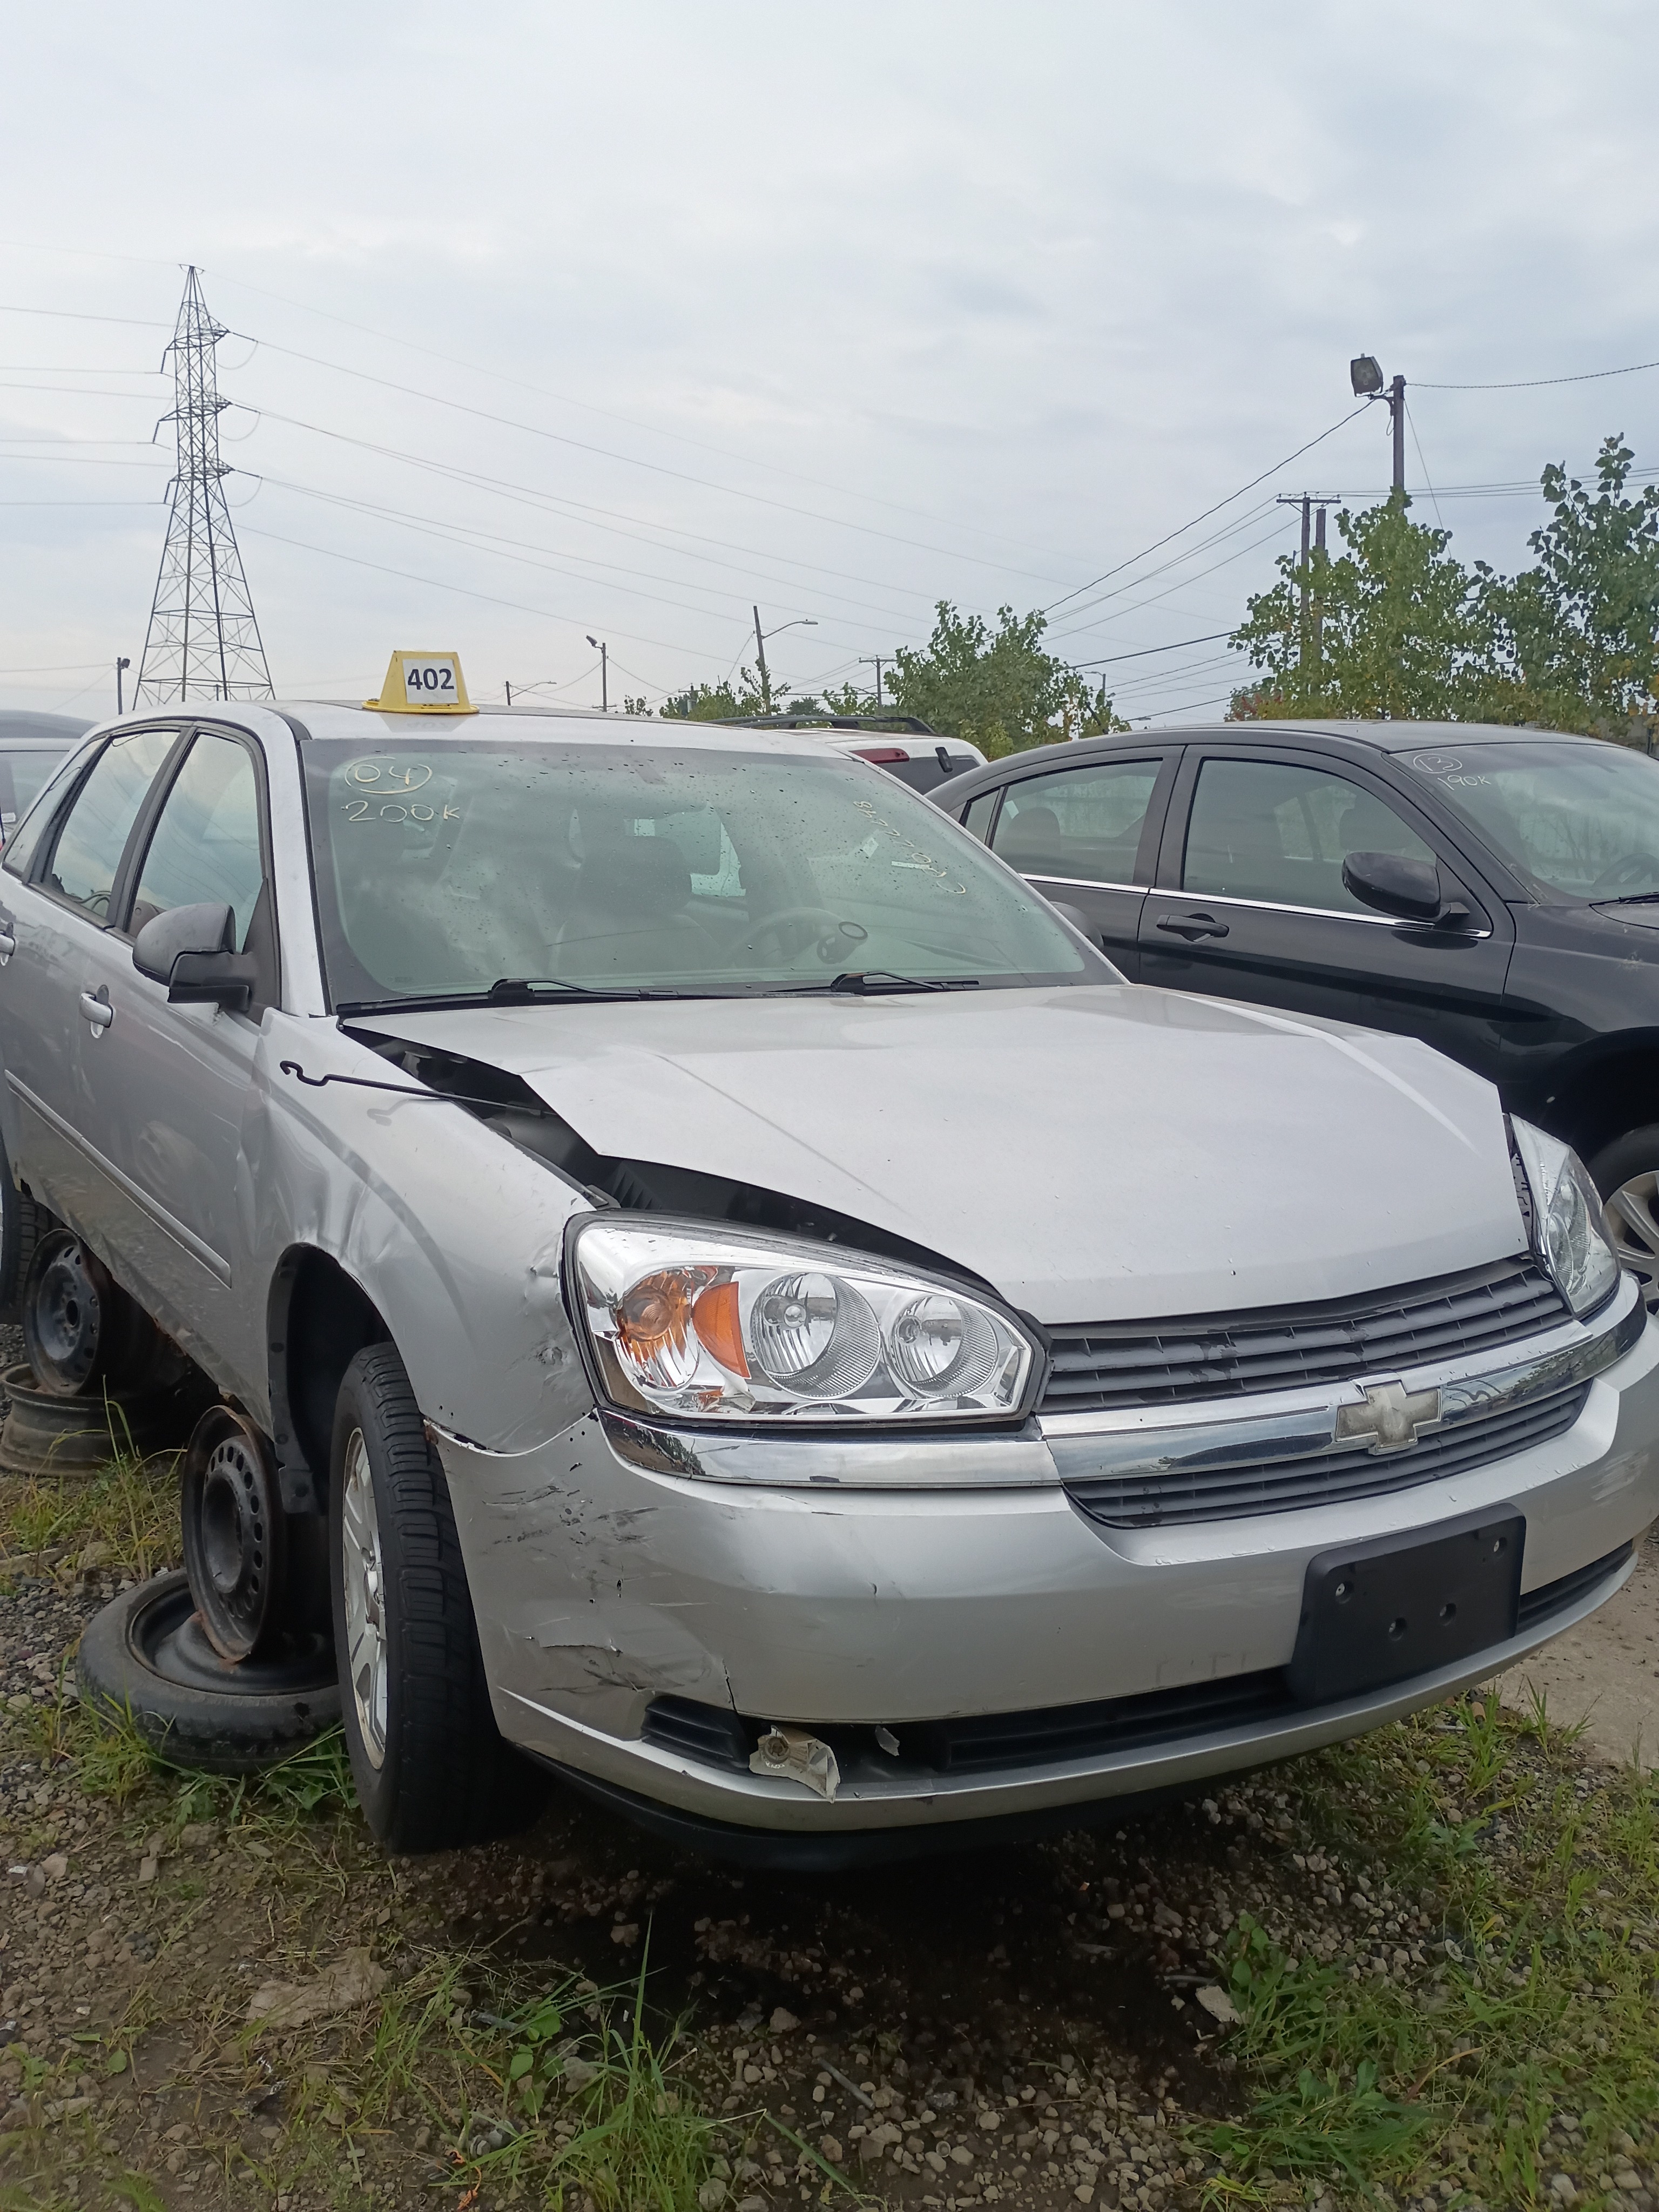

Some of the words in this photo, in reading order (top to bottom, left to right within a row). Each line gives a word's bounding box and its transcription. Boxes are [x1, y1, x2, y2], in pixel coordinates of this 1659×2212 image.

[407, 668, 455, 690] 402
[354, 764, 414, 786] 04
[1419, 757, 1453, 771] 13
